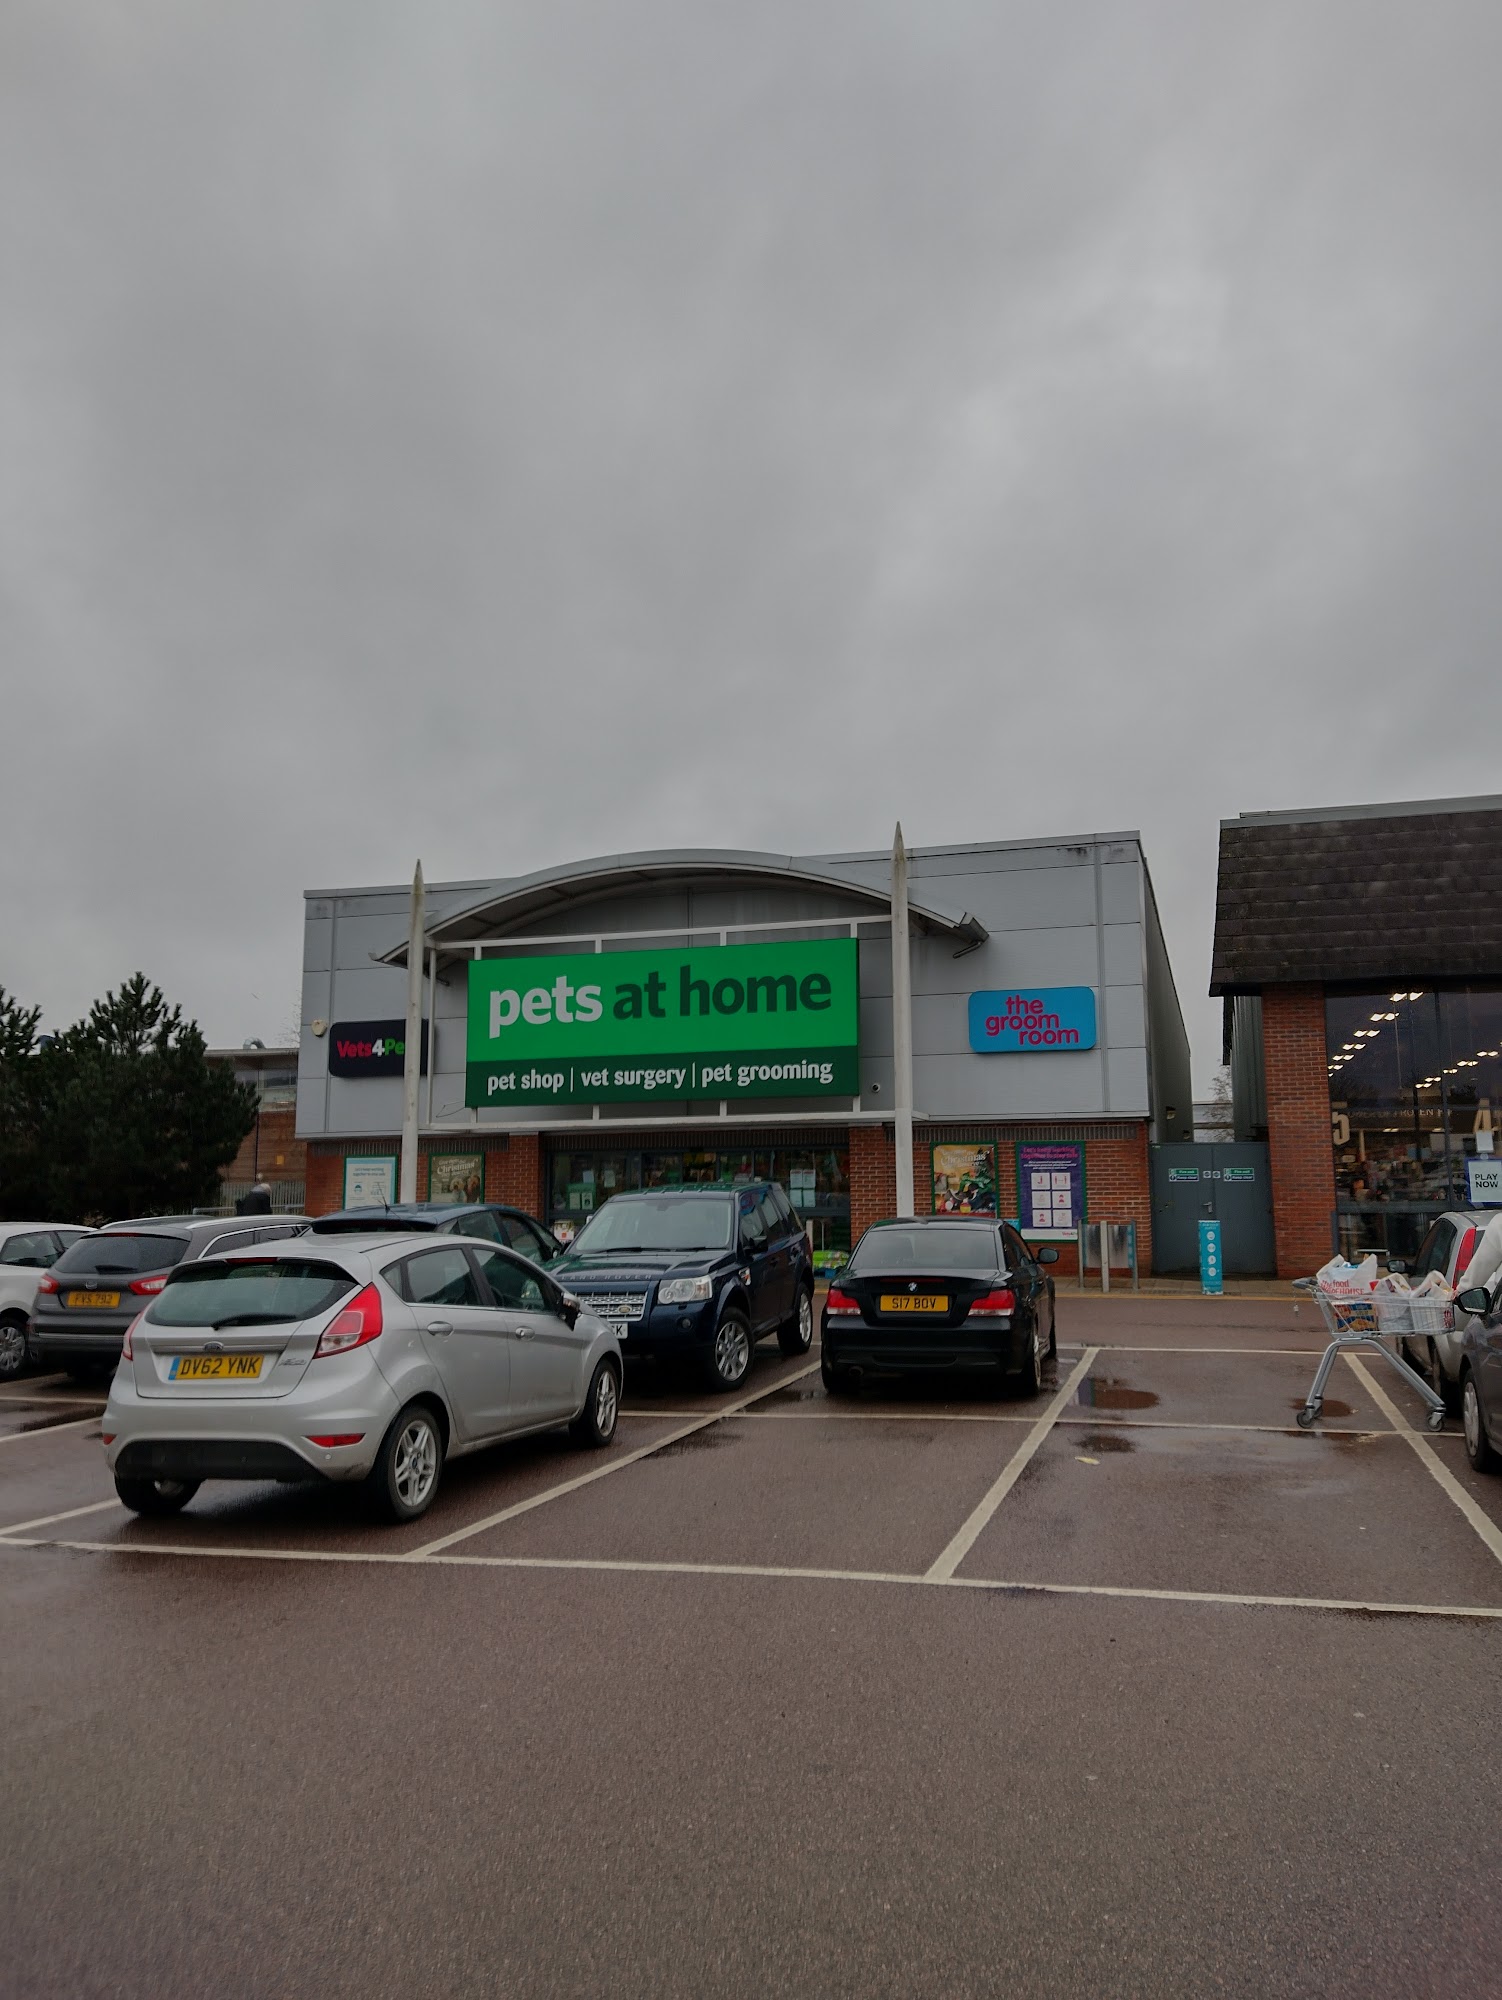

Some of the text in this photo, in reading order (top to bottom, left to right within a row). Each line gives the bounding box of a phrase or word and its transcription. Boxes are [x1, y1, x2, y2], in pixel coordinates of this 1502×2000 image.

[489, 964, 832, 1039] pets at home
[1005, 994, 1044, 1015] the
[985, 1013, 1060, 1036] groom
[1018, 1028, 1080, 1046] room
[336, 1038, 404, 1058] Vets4Pe
[487, 1059, 834, 1096] pet shop vet surgery pet grooming
[1474, 1173, 1498, 1181] PLAY
[1475, 1180, 1499, 1188] NOW
[180, 1357, 223, 1376] DV62
[227, 1356, 261, 1374] YNK
